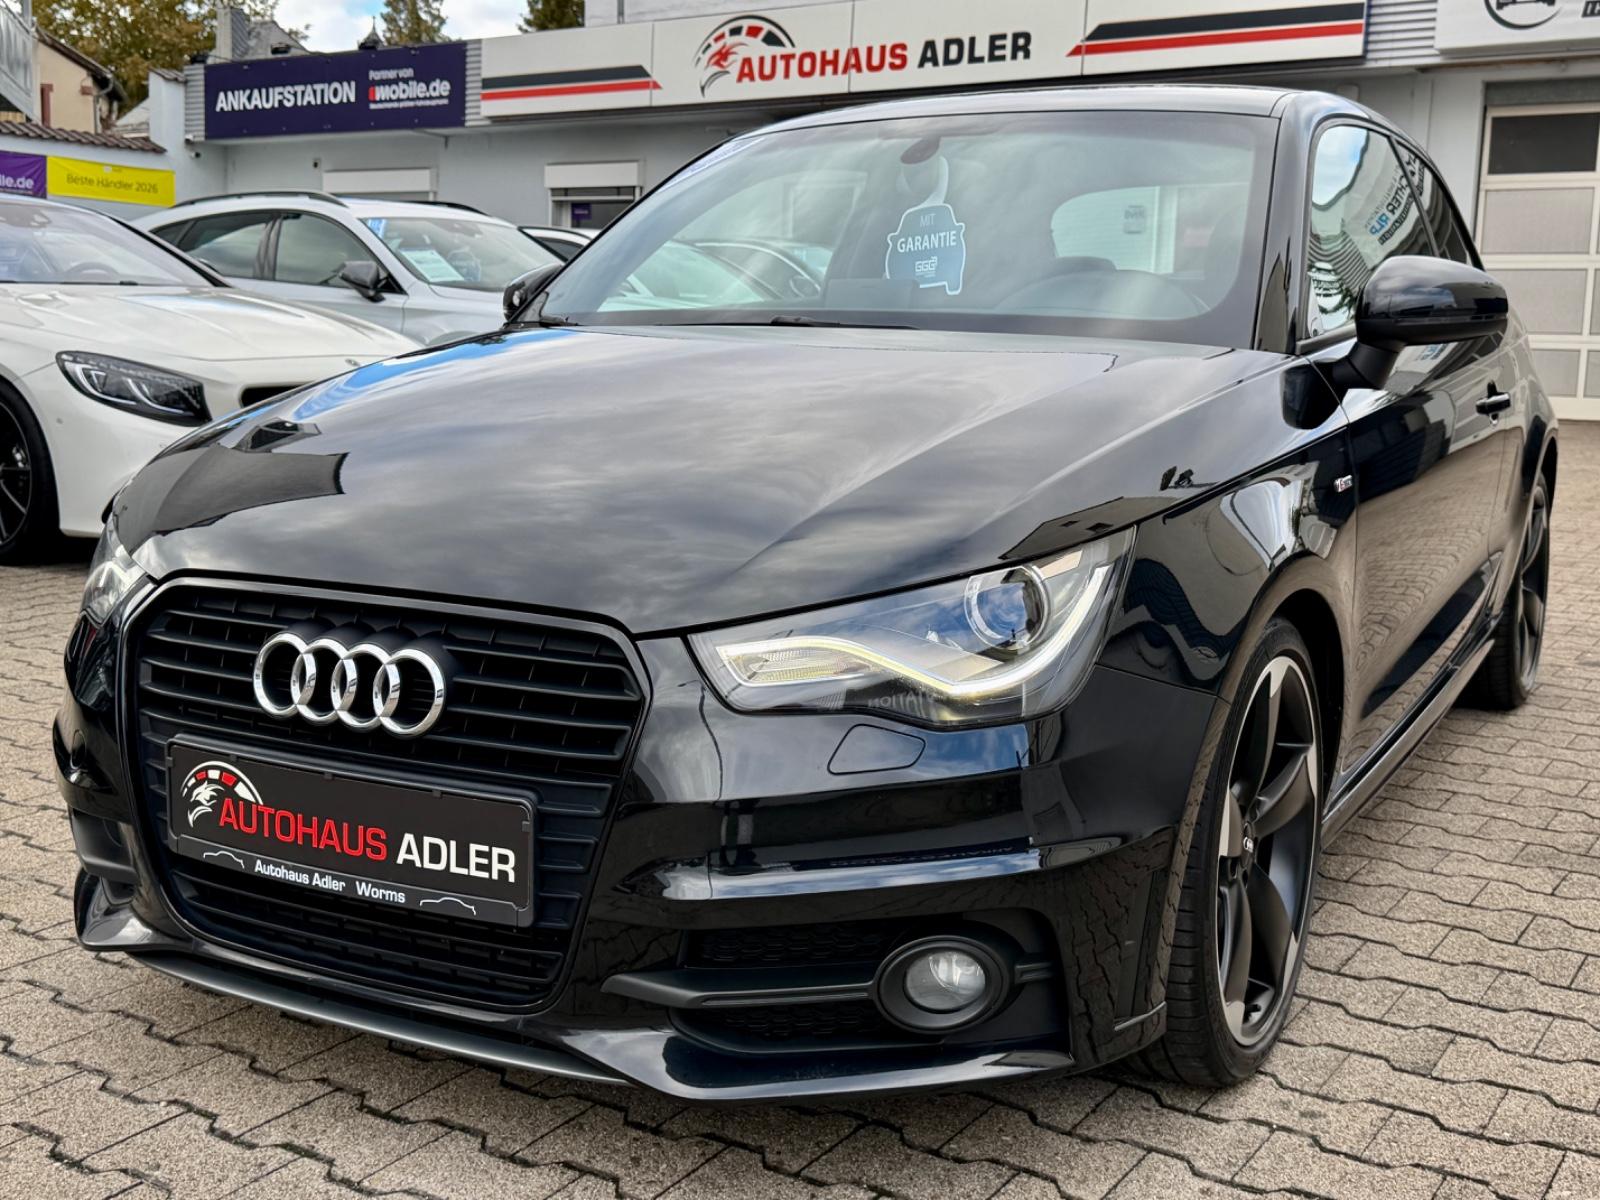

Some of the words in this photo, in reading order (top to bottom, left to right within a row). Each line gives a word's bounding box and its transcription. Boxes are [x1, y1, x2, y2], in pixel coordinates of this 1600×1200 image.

[736, 43, 909, 83] AUTOHAUS
[917, 31, 1032, 69] ADLER
[215, 80, 356, 112] ANKAUFSTATION
[373, 78, 451, 101] mobile.de
[66, 174, 95, 187] Beste
[97, 175, 134, 191] Händler
[136, 181, 159, 194] 2026
[920, 213, 936, 227] MIT
[897, 230, 957, 253] GARANTIE
[218, 797, 388, 861] AUTOHAUS
[396, 832, 516, 883] ADLER
[254, 859, 310, 885] Autohaus
[312, 872, 346, 892] Adler
[356, 880, 406, 903] Worms
